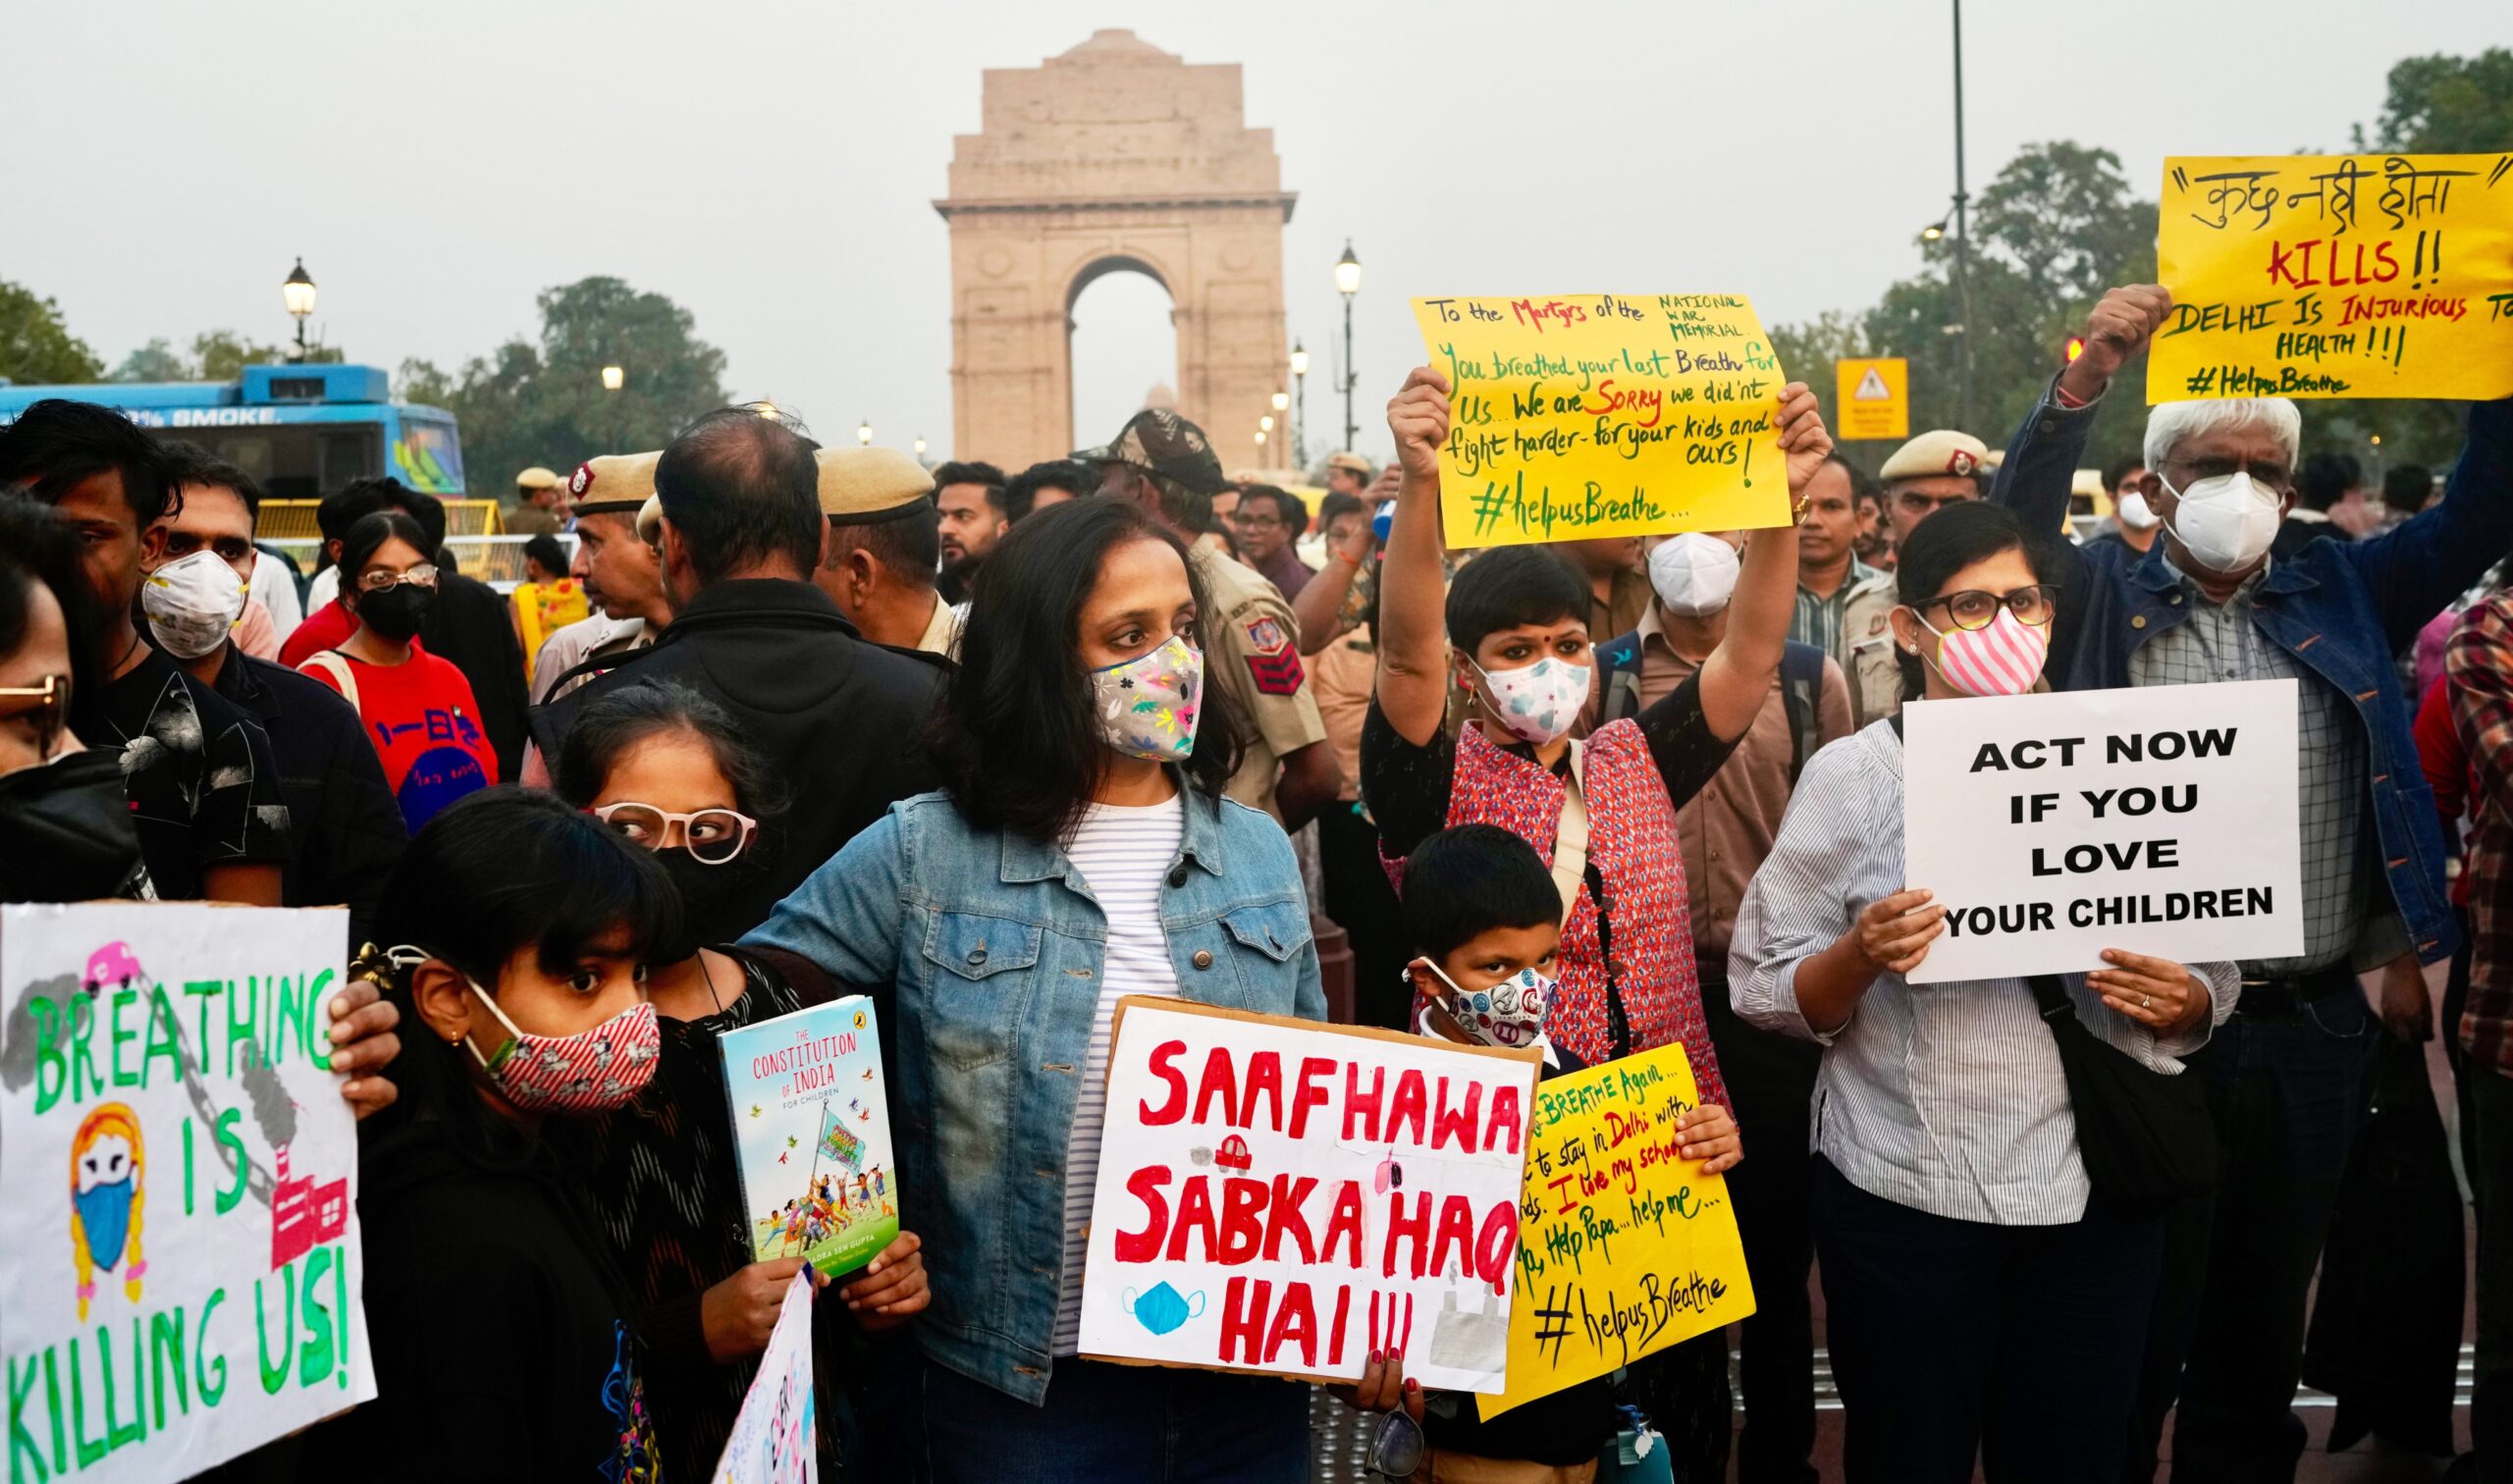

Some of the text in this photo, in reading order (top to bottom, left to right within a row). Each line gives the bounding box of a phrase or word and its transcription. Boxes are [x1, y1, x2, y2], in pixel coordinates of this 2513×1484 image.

[1425, 294, 1645, 334] To the Martyrs of the
[1658, 293, 1744, 309] NATIONAL
[1666, 310, 1706, 322] WAR
[2160, 299, 2284, 340] DELHI
[2292, 292, 2324, 326] IS
[1439, 341, 1776, 401] You breathed your last Breath for
[1514, 381, 1544, 420] We
[1553, 395, 1583, 414] are
[1671, 387, 1694, 404] we
[1445, 426, 1510, 478] fight
[1594, 415, 1630, 446] for
[1619, 425, 1678, 460] your
[1684, 414, 1724, 442] kids
[1731, 410, 1770, 435] and
[1969, 727, 2238, 773] ACT NOW
[2010, 783, 2199, 824] IF YOU
[2031, 838, 2179, 877] LOVE
[1944, 885, 2273, 938] YOUR CHILDREN
[27, 967, 335, 1116] BREATHING
[752, 1031, 857, 1080] CONSTITUTION
[795, 1029, 810, 1041] THE
[781, 1062, 835, 1097] OF INDIA
[782, 1086, 839, 1109] FOR CHILDREN
[1538, 1075, 1617, 1125] BREATHE
[182, 1107, 249, 1217] IS
[1535, 1147, 1552, 1178] to
[1558, 1137, 1586, 1181] stay
[1592, 1127, 1609, 1153] in
[1604, 1110, 1650, 1149] Delhi
[1655, 1094, 1693, 1126] with
[1547, 1173, 1578, 1216] I
[1578, 1169, 1610, 1198] love
[1611, 1157, 1637, 1195] my
[1639, 1139, 1681, 1169] schoo
[849, 1233, 876, 1248] GUPTA
[1115, 1164, 1519, 1298] SABKA HAQ
[1545, 1221, 1582, 1276] Help
[1630, 1189, 1665, 1239] help
[1533, 1269, 1728, 1372] #helpusBreathe
[7, 1245, 348, 1484] KILLING US!
